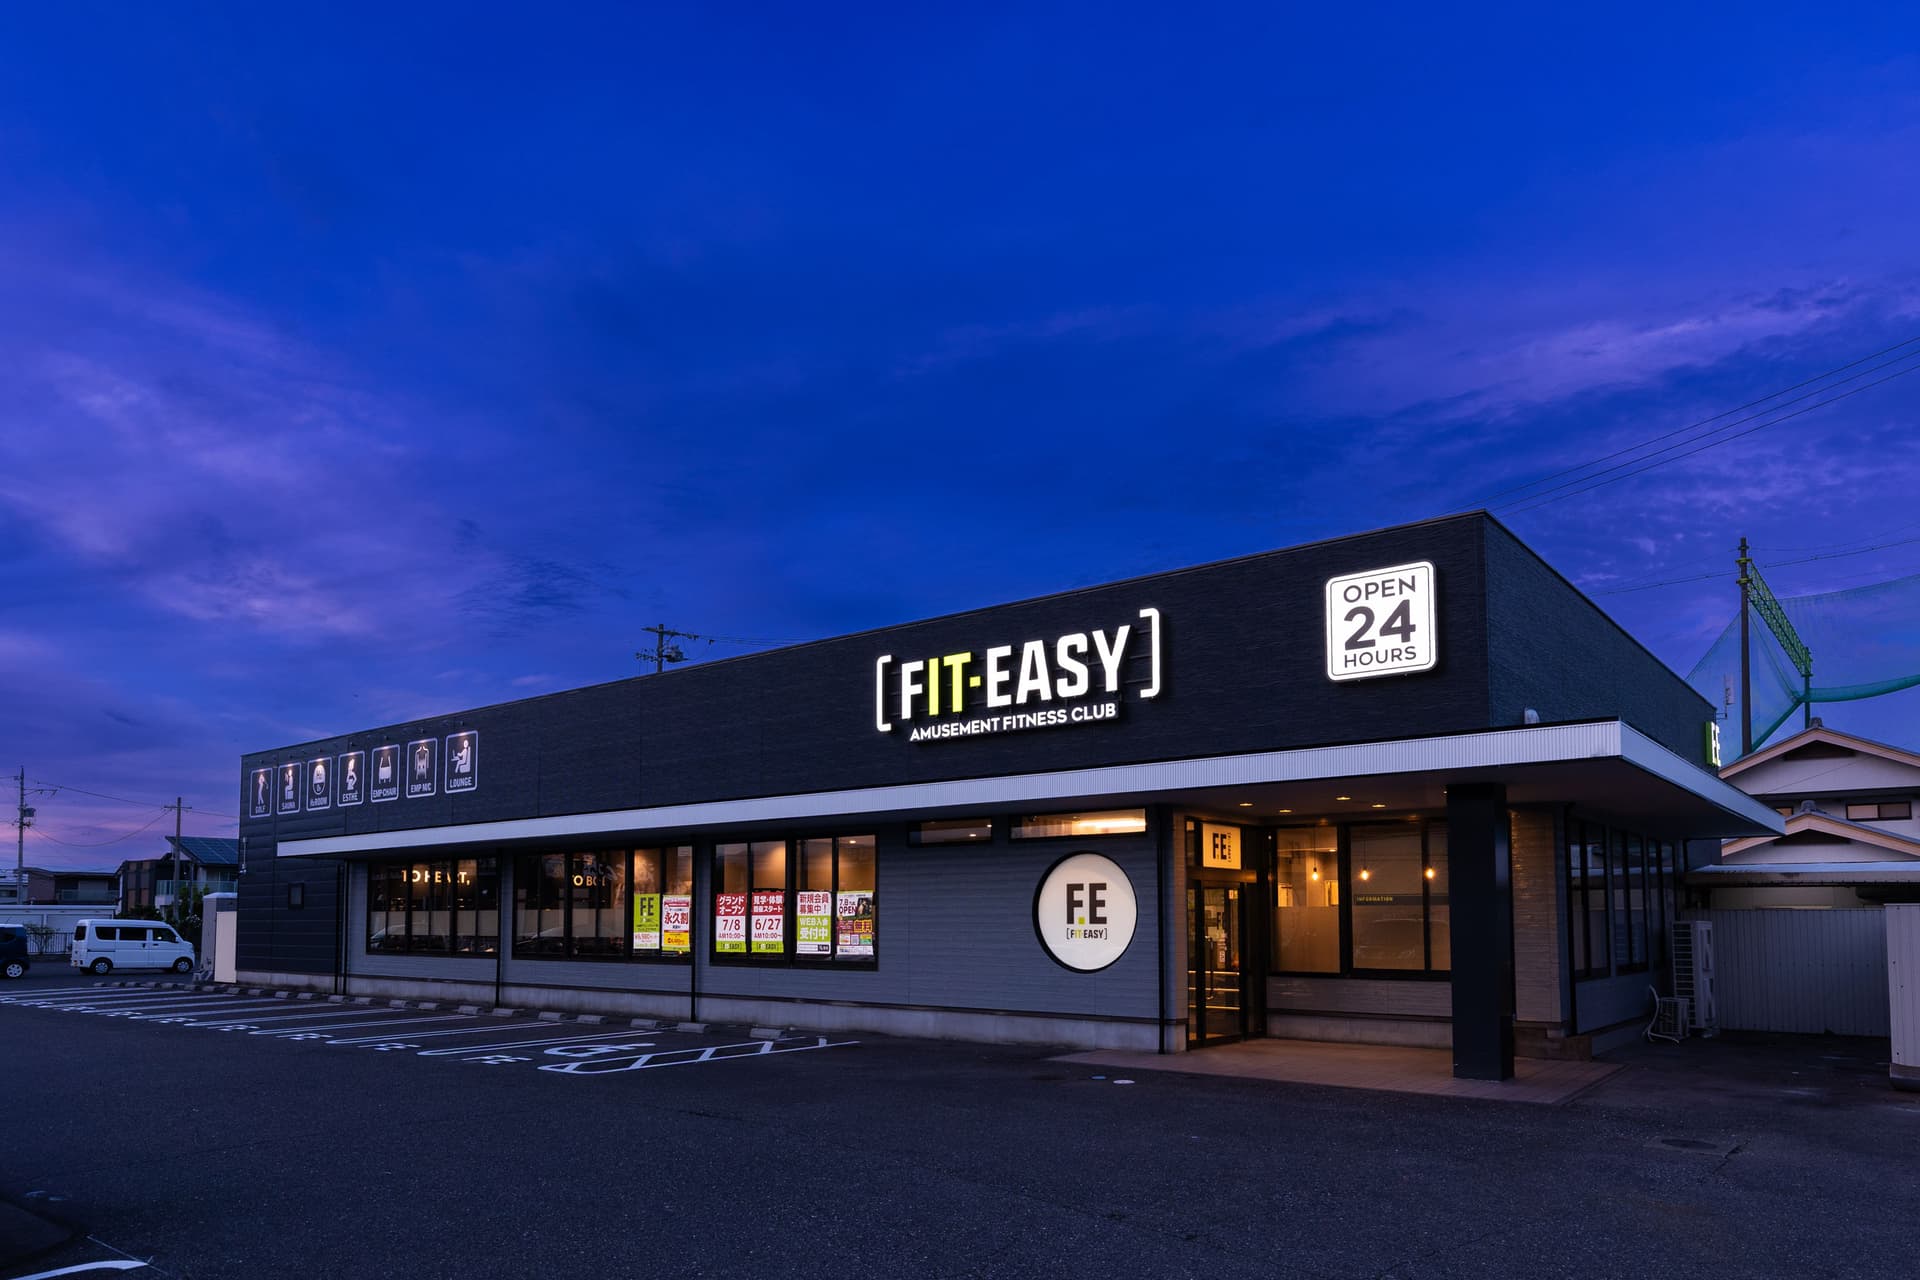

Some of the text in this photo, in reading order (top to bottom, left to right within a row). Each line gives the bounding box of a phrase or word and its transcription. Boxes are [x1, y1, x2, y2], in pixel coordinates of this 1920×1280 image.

[1343, 575, 1416, 603] OPEN
[1343, 599, 1417, 650] 24
[1344, 646, 1417, 668] HOURS
[910, 703, 1117, 742] AMUSEMENT FITNESS CLUB
[449, 777, 473, 788] LOUNGE
[719, 896, 745, 906] グランド
[799, 893, 829, 904] 新規会員
[719, 905, 745, 915] オープン
[838, 905, 857, 915] OPEN
[664, 912, 689, 925] 永久割
[722, 919, 741, 931] 7/8
[755, 918, 781, 931] 6/27
[799, 927, 829, 941] 受付中
